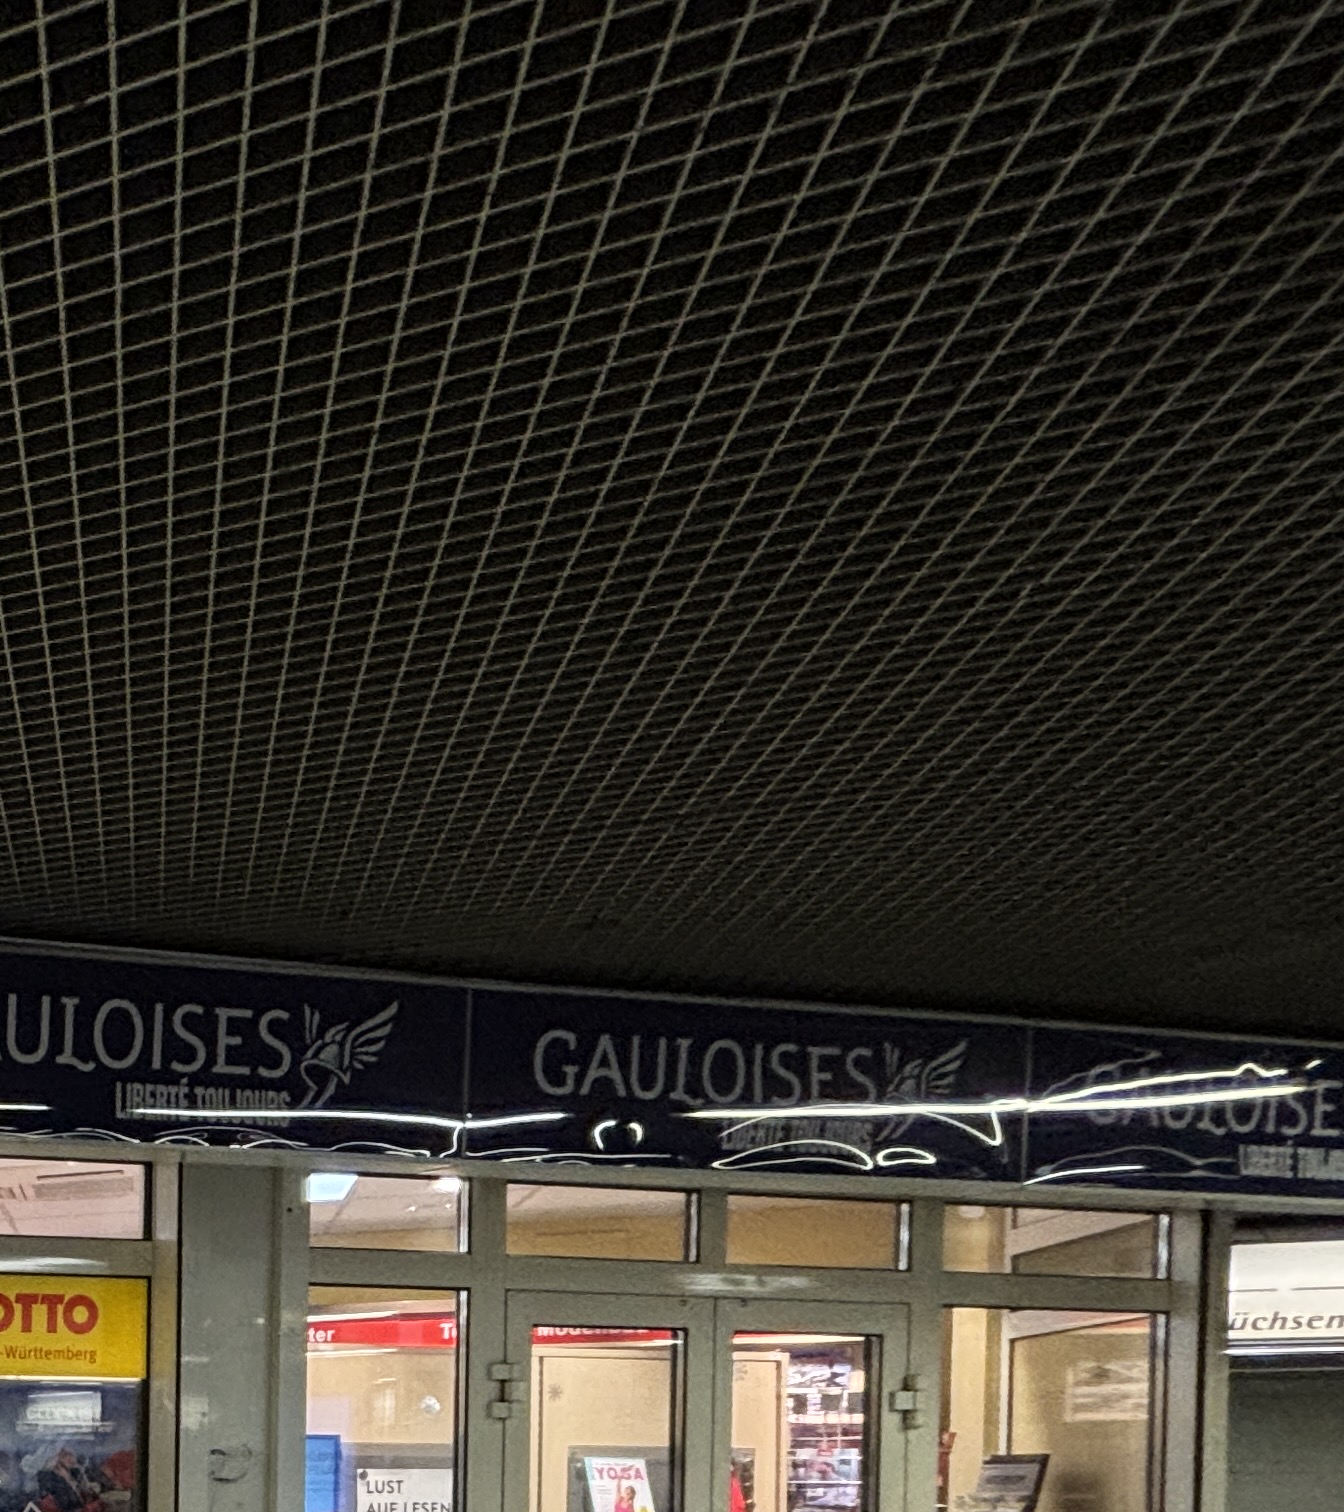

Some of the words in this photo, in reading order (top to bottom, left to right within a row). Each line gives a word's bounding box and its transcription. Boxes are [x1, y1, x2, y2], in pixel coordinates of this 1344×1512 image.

[533, 1029, 877, 1105] GAULOISES
[594, 1465, 645, 1480] YOGA
[366, 1479, 404, 1494] LUST
